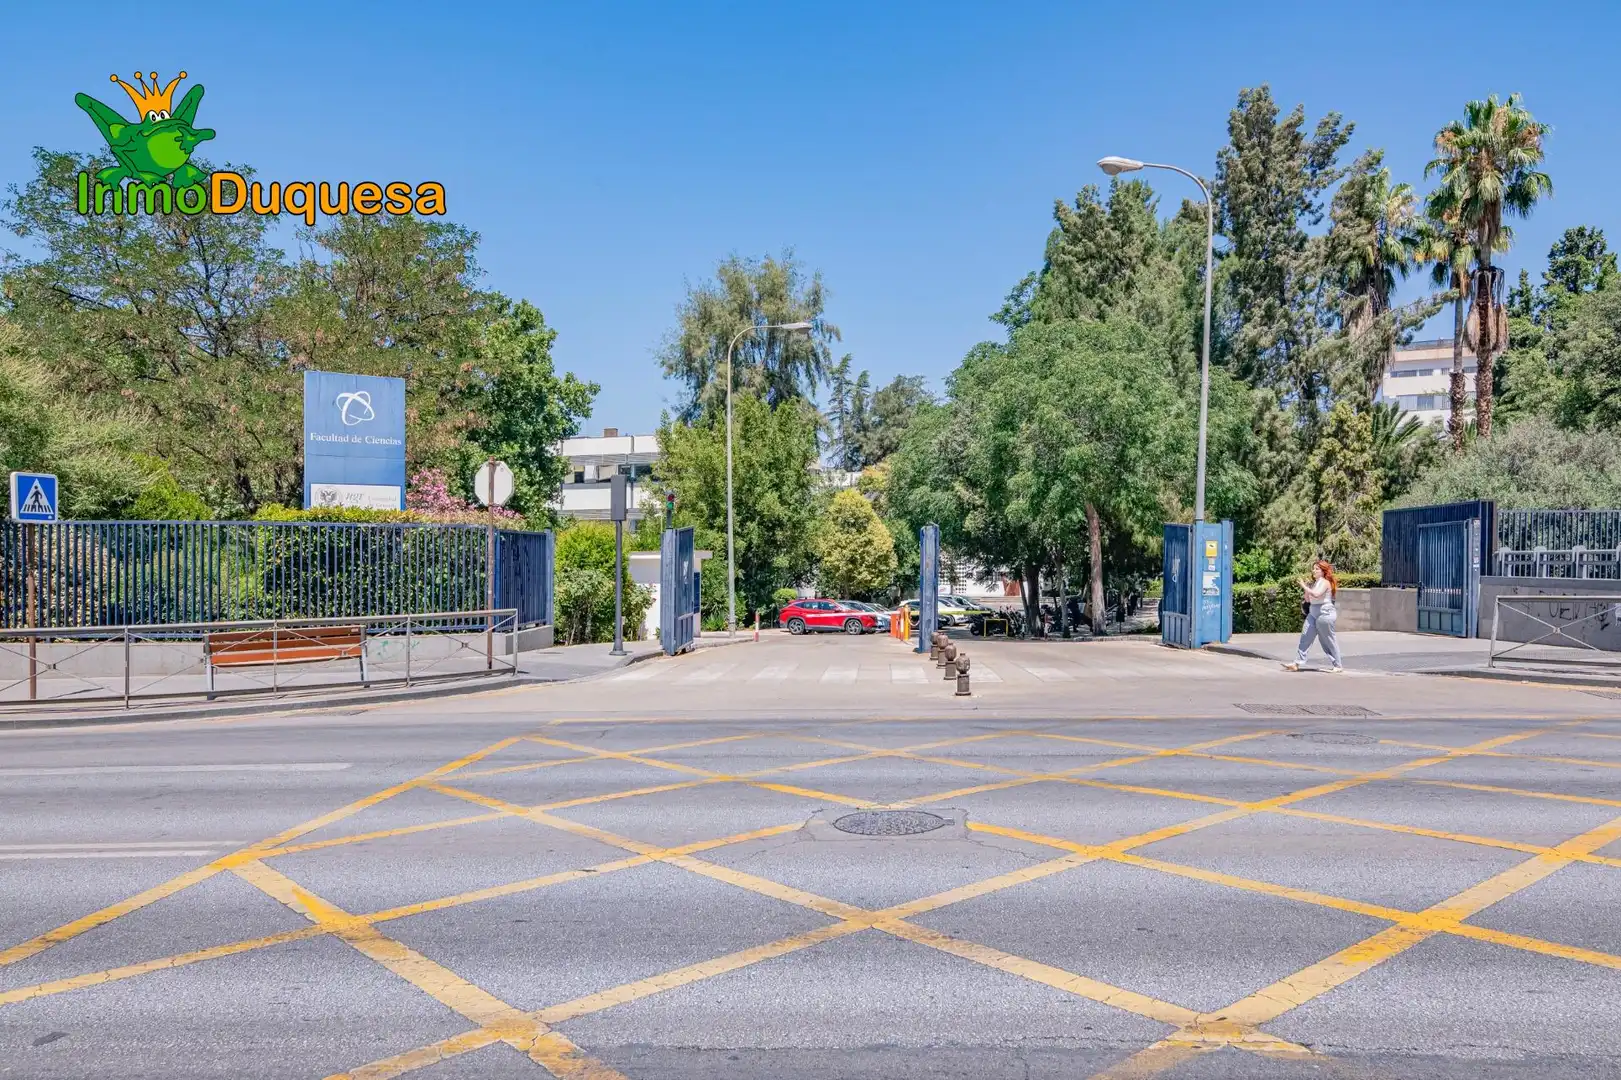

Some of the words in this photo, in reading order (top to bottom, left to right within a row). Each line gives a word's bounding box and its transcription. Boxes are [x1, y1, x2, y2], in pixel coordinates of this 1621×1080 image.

[310, 432, 349, 443] Facultad
[351, 434, 362, 444] de
[365, 435, 402, 446] Ciencias
